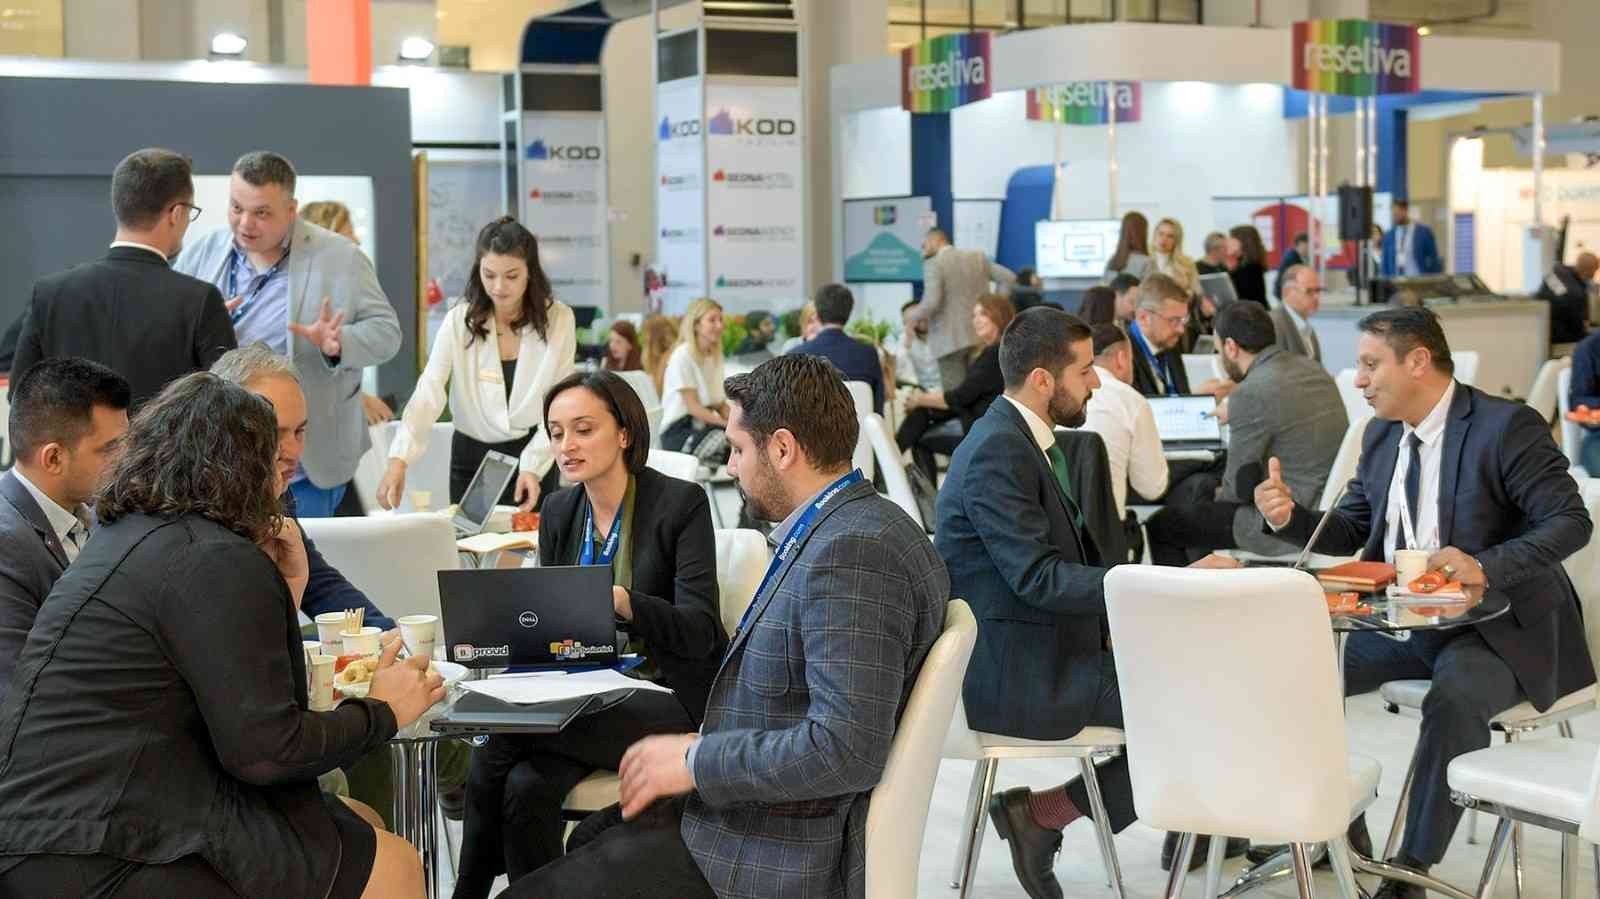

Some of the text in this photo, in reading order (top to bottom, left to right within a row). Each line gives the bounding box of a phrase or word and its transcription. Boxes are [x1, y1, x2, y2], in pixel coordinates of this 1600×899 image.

[1304, 36, 1411, 78] reseliva
[907, 49, 985, 94] reseliva
[737, 119, 796, 136] KOD
[549, 145, 601, 160] KOD
[473, 645, 509, 658] proud
